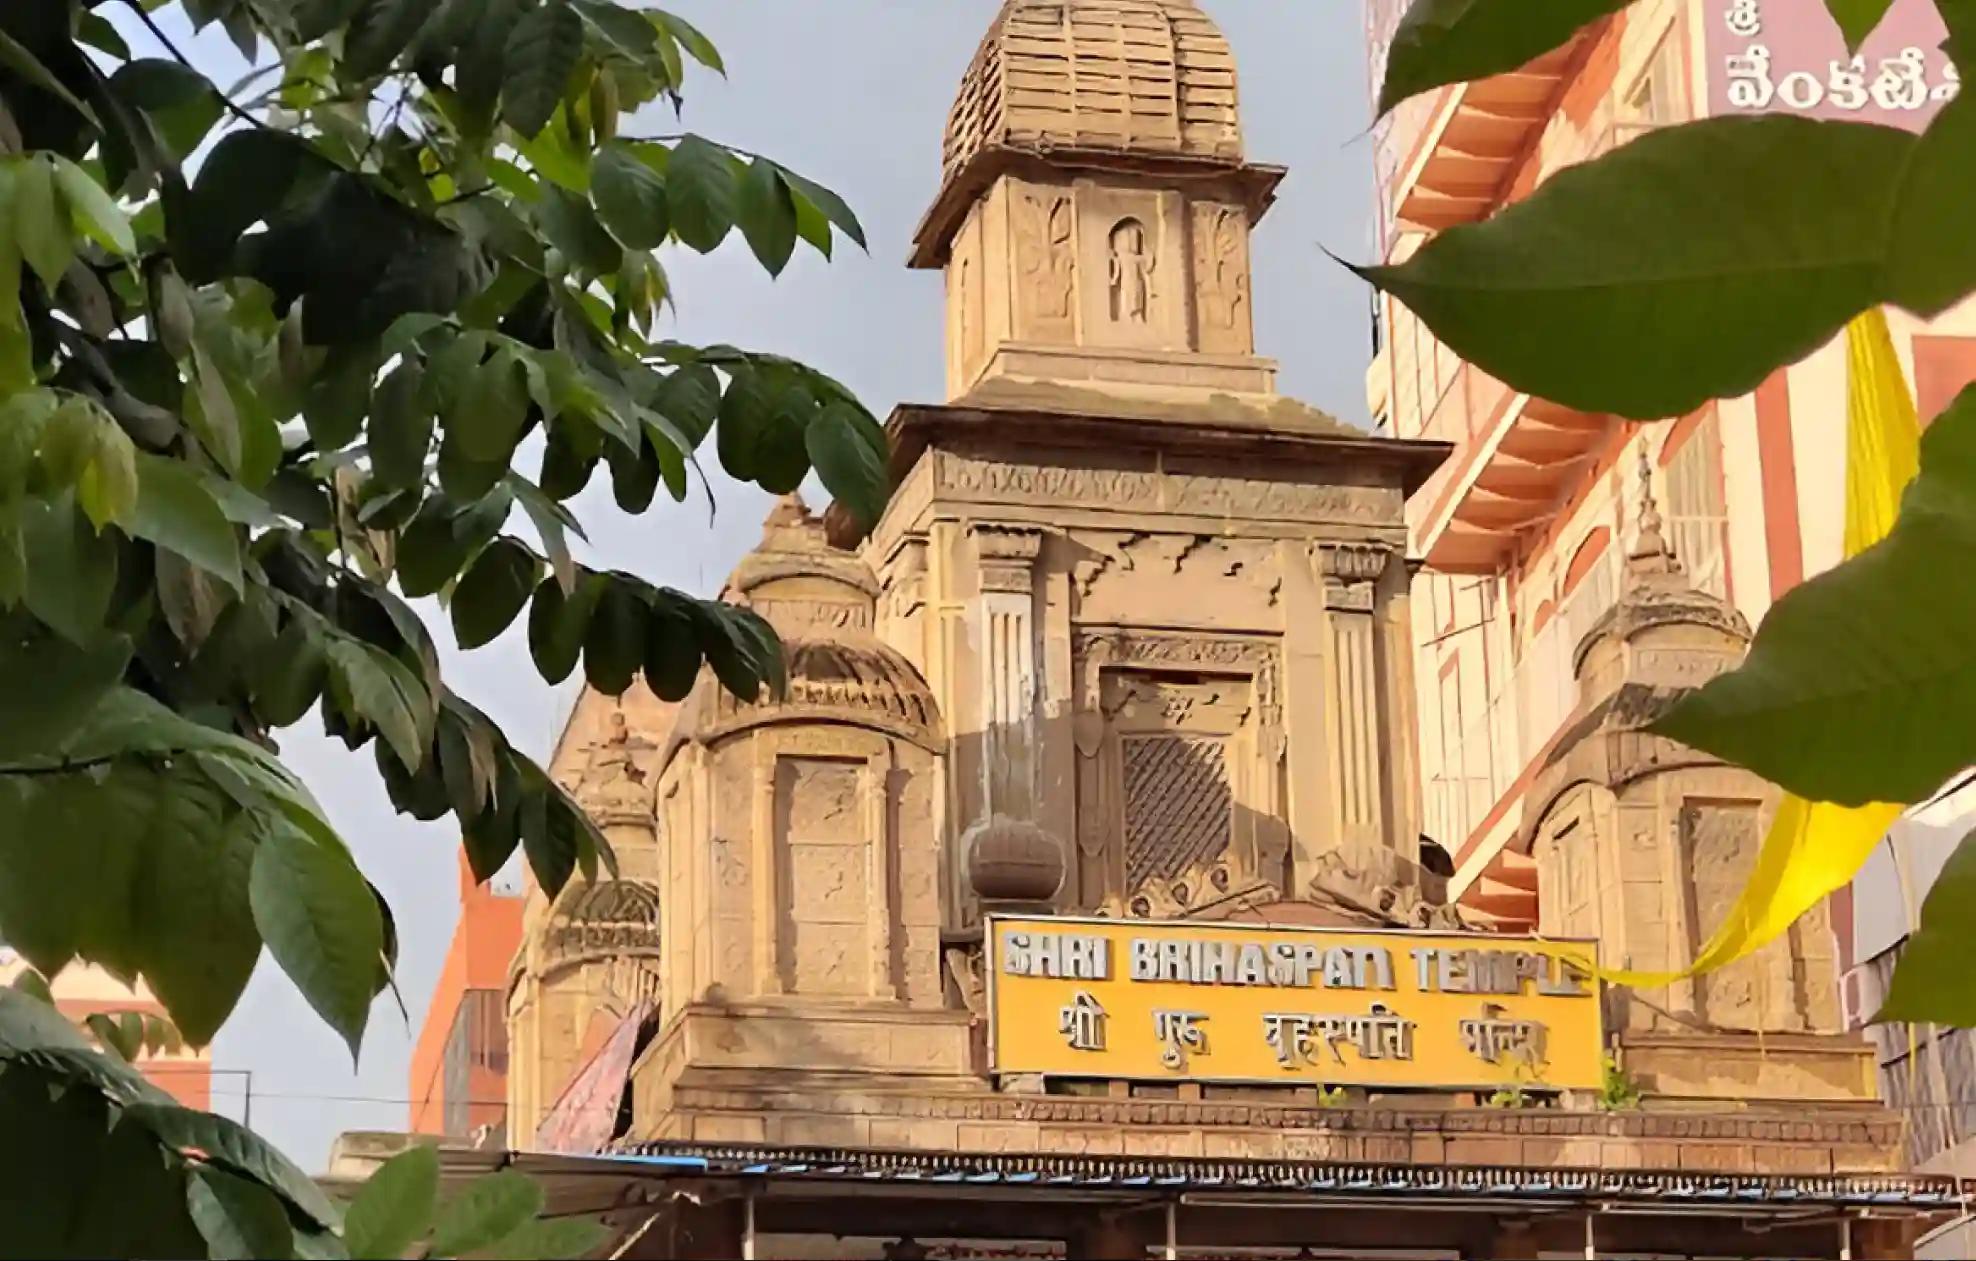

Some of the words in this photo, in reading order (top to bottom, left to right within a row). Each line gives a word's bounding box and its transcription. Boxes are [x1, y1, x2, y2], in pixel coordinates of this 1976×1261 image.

[1004, 932, 1110, 980] SHRI
[1130, 938, 1396, 990] BRIHASPATI
[1059, 991, 1110, 1052] श्री
